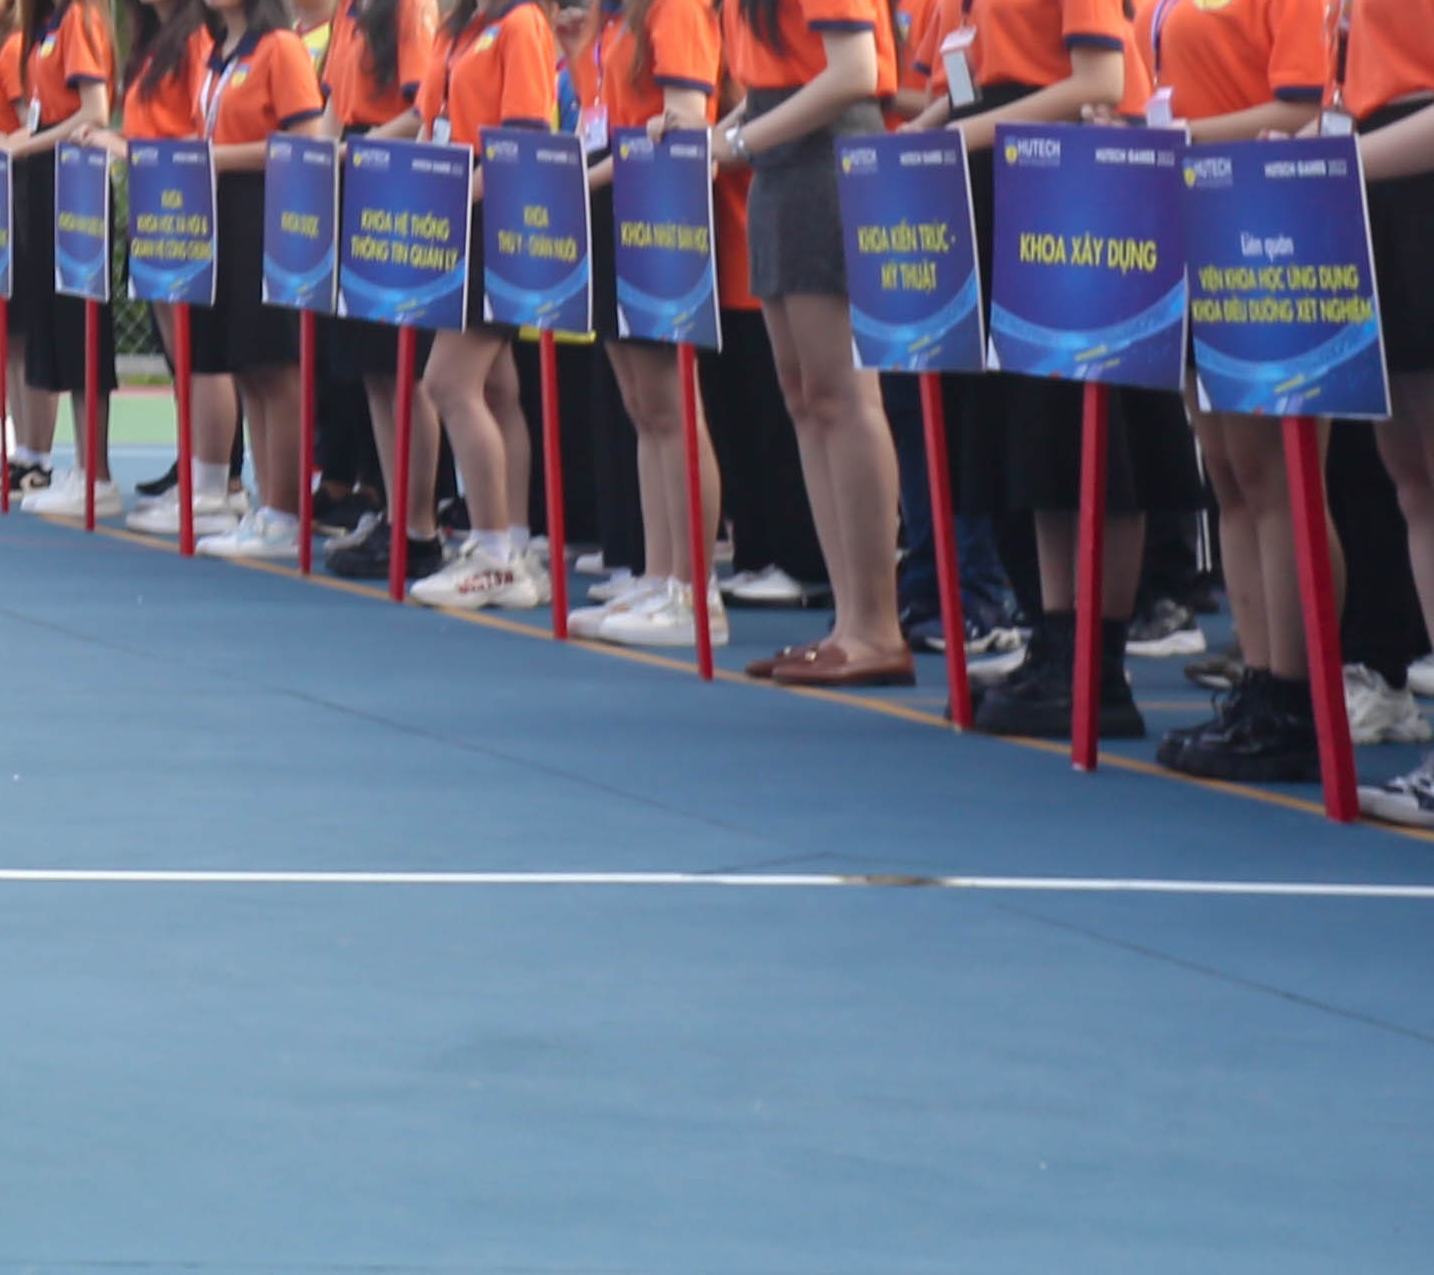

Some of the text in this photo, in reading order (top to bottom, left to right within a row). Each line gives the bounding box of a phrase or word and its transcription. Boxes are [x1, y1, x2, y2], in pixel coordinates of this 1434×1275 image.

[1018, 138, 1061, 158] HUTECH
[1095, 149, 1125, 164] HUTECH
[1128, 150, 1155, 165] GAMES
[1194, 157, 1233, 178] HUTECH
[361, 207, 392, 234] KHOA
[620, 222, 652, 248] KHOA
[858, 226, 888, 253] KHOA
[391, 240, 408, 265] TIN
[1019, 230, 1158, 275] KHOA XÂY DỰNG
[1225, 266, 1256, 290] KHOA
[1259, 265, 1285, 293] HỌC
[1193, 298, 1222, 322] KHOA
